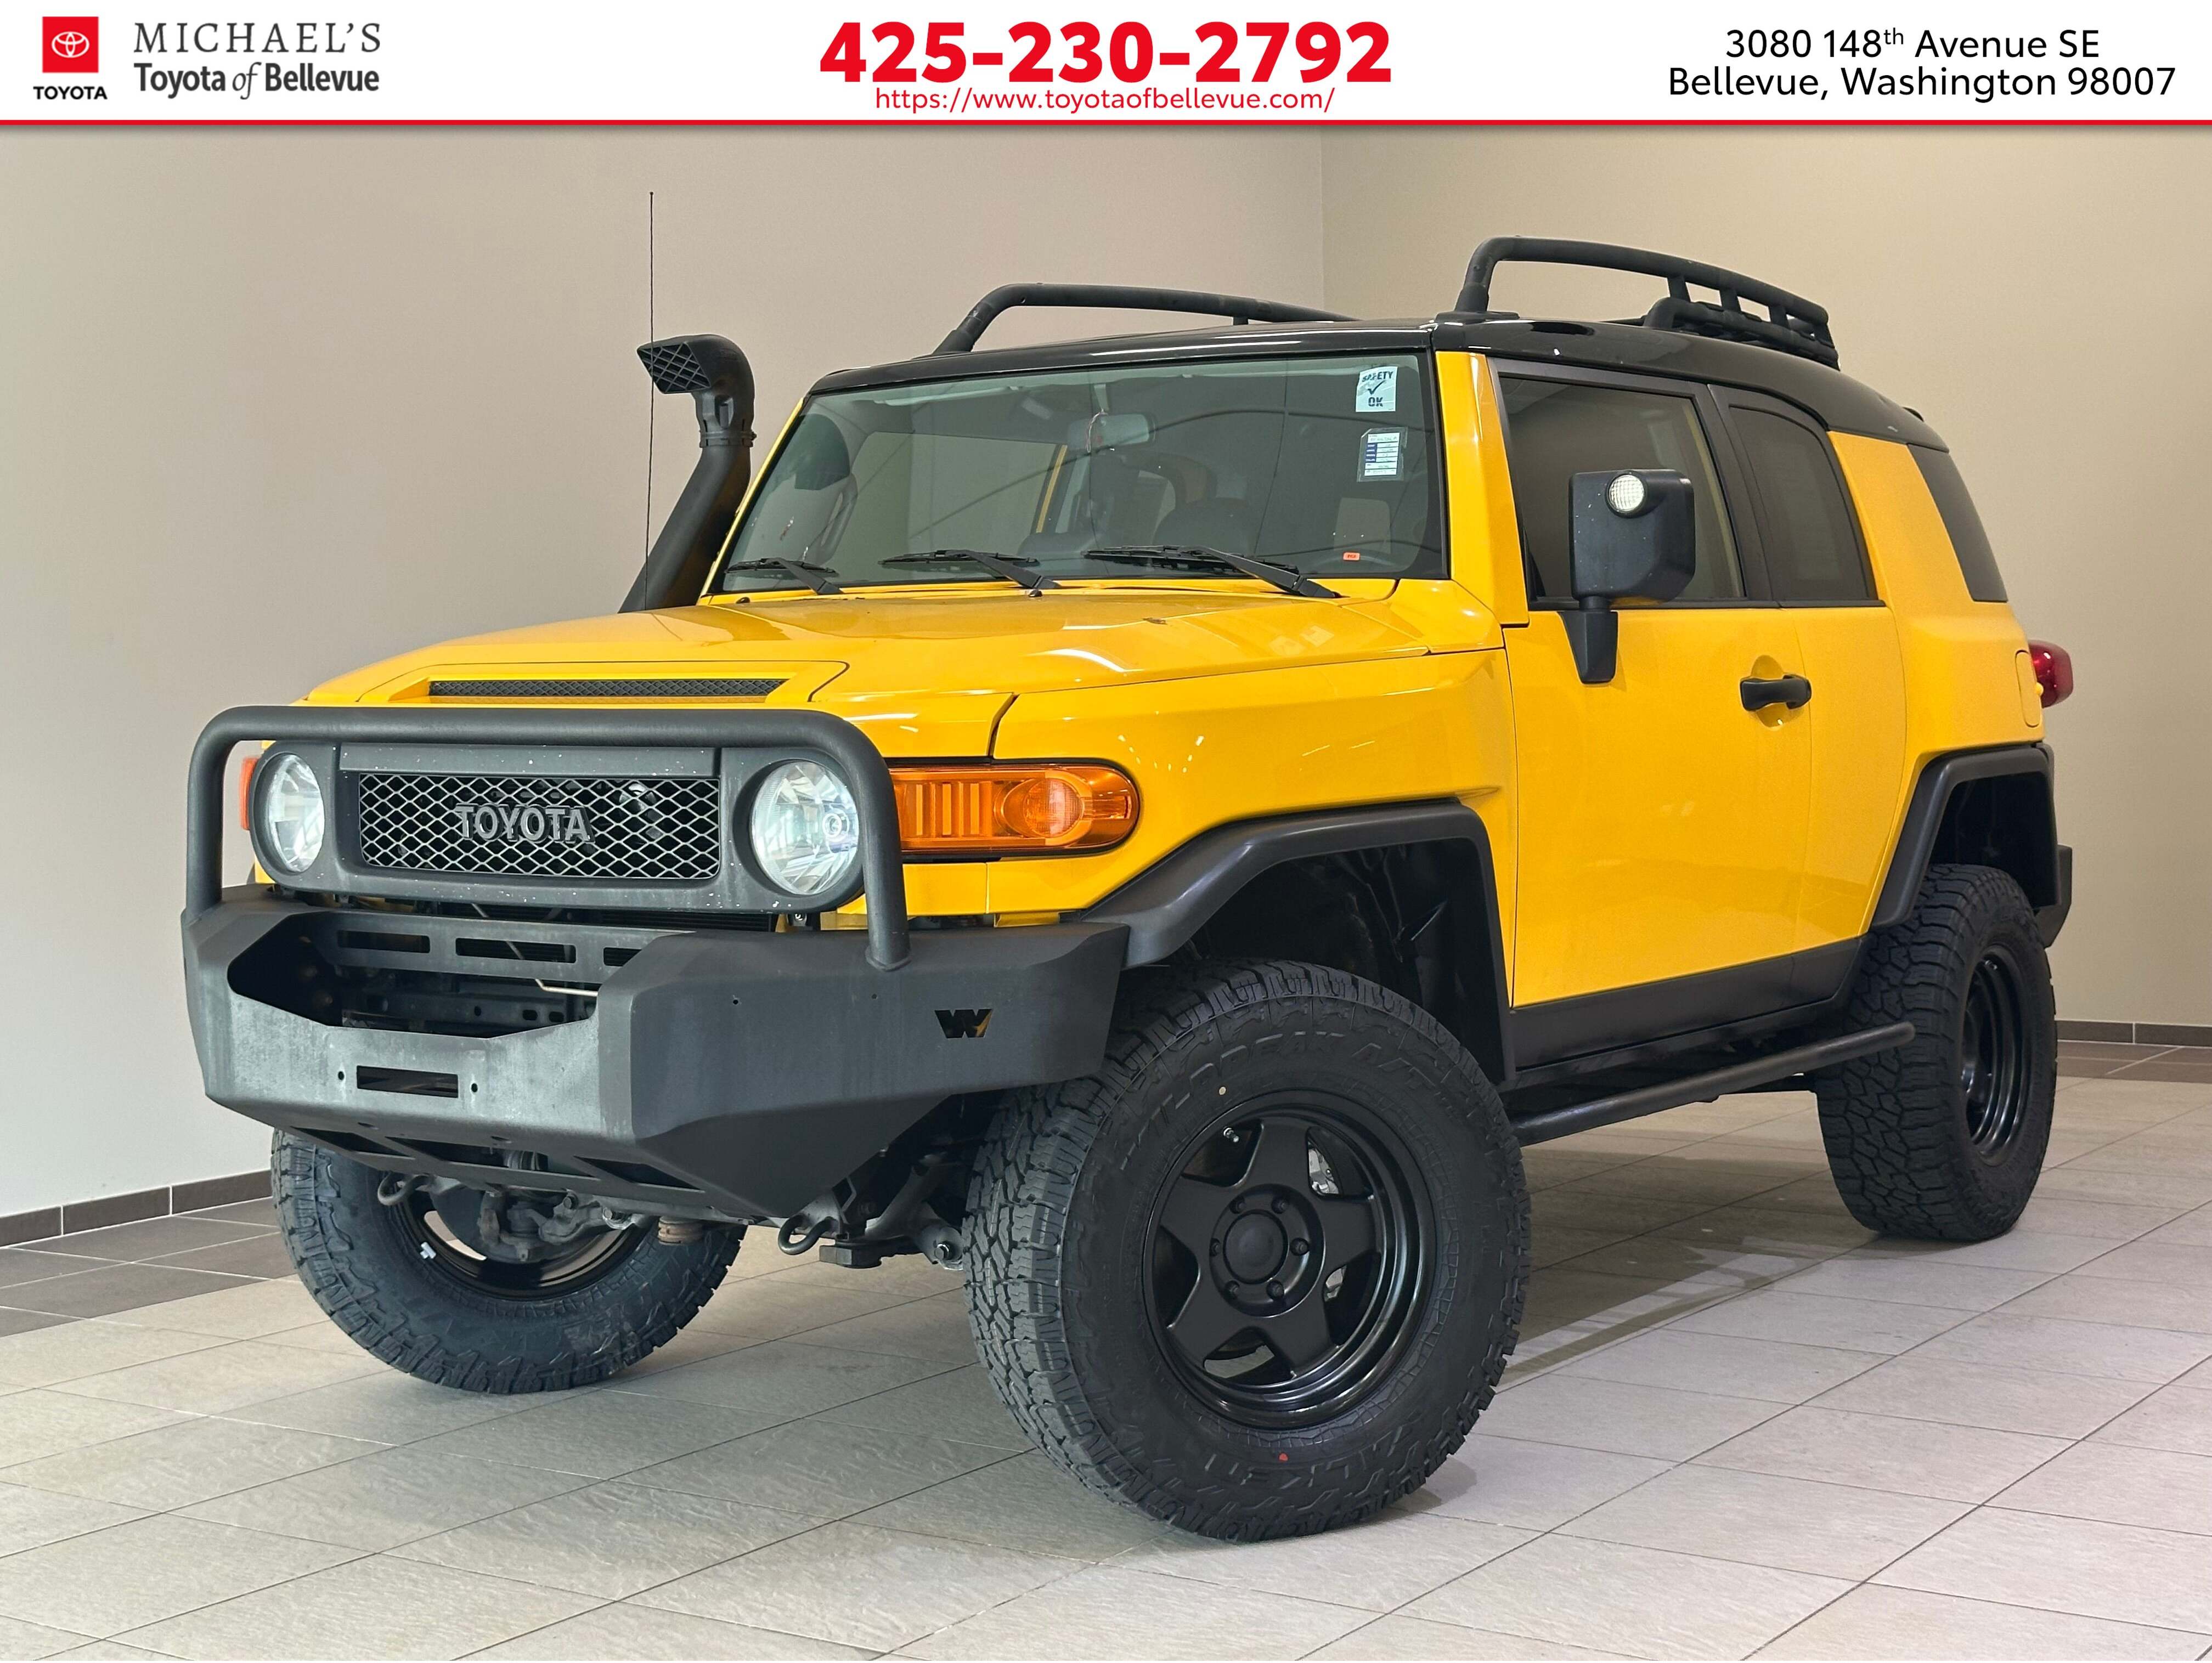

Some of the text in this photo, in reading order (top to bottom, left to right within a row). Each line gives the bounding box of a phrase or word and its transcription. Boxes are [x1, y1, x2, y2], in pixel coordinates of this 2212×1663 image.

[1362, 371, 1393, 382] SAFETY
[1368, 397, 1383, 407] OK
[455, 804, 595, 843] TOYOTA
